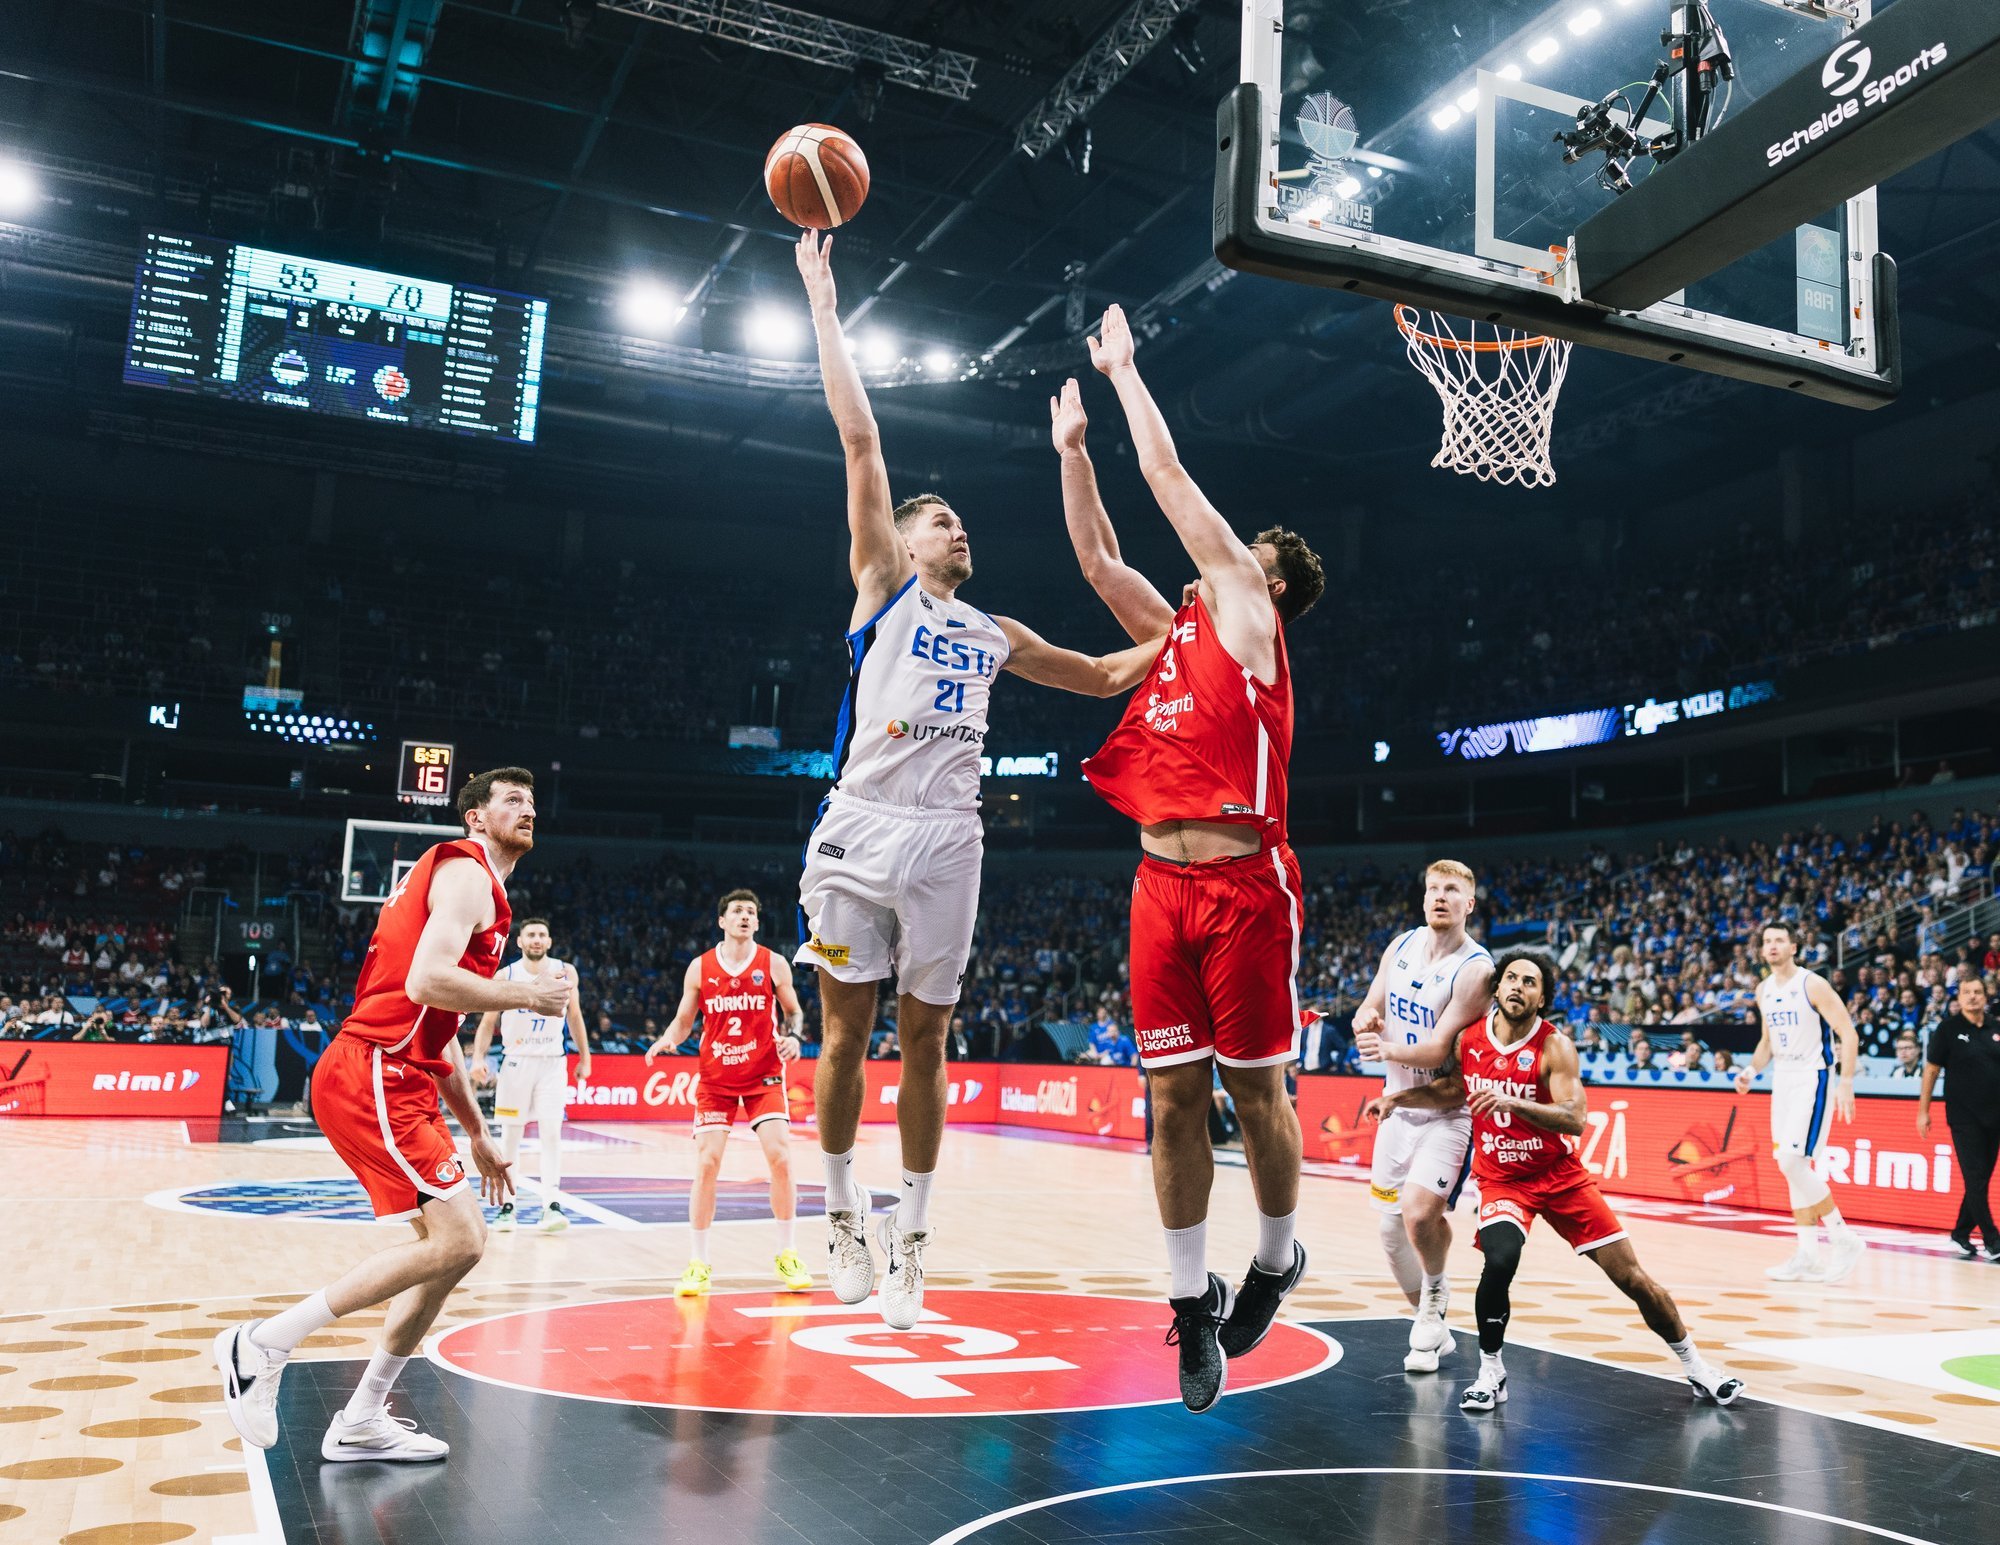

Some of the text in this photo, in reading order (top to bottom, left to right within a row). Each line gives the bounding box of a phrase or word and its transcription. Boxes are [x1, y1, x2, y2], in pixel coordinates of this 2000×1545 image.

[1766, 41, 1948, 168] Schelde Sports
[279, 263, 318, 292] 55
[385, 281, 423, 312] 70
[911, 625, 996, 679] EESTI
[933, 679, 966, 713] 21
[1681, 689, 1725, 720] YOUR
[414, 747, 450, 765] 6:37
[417, 766, 445, 793] 16
[819, 843, 845, 858] BALLZY
[240, 922, 274, 939] 108
[705, 992, 766, 1014] TÜRKİYE
[1390, 992, 1435, 1030] EESTI
[531, 1018, 546, 1032] 77
[727, 1017, 742, 1036] 2
[1766, 1011, 1799, 1028] EESTI
[722, 1039, 757, 1056] Garanti
[722, 1053, 750, 1066] BBVA
[93, 1071, 176, 1092] Rimi
[1463, 1072, 1537, 1101] TÜRKİYE
[1494, 1134, 1543, 1151] Garanti
[1498, 1150, 1533, 1164] BBVA
